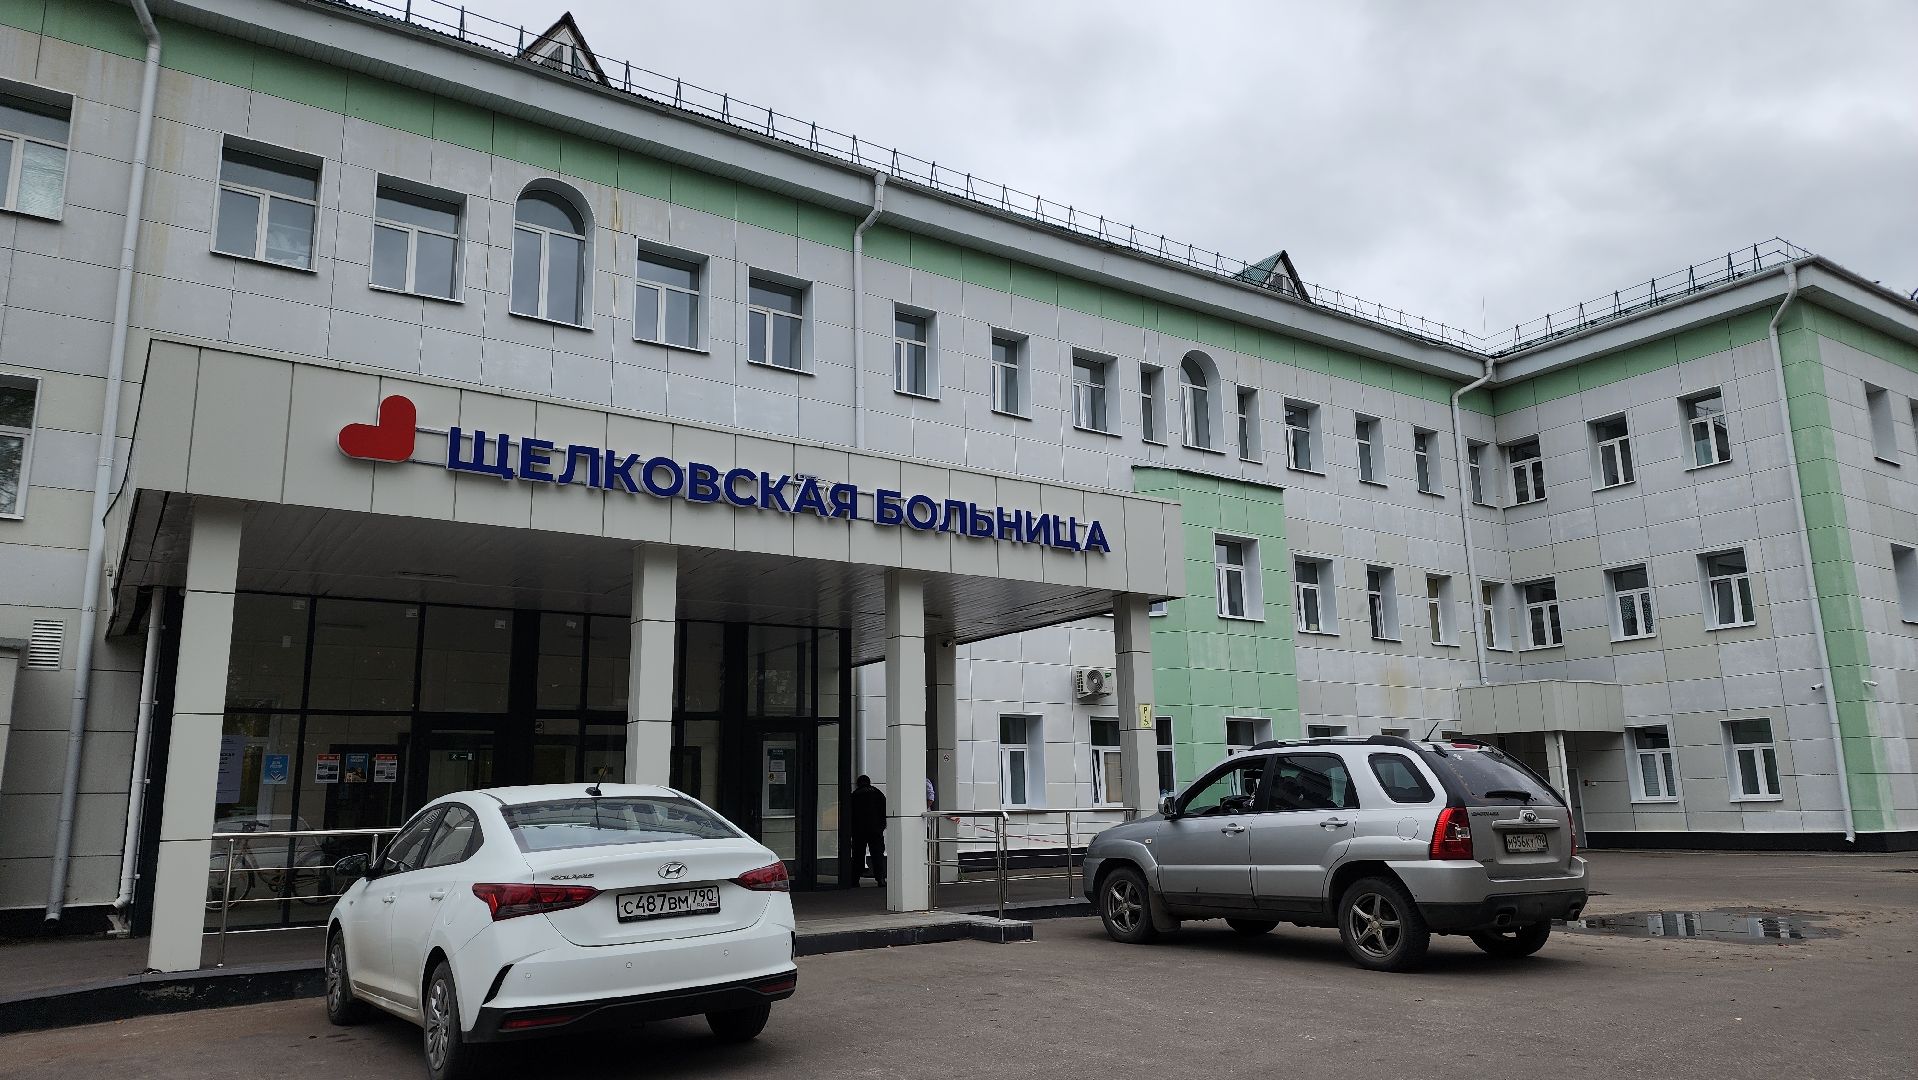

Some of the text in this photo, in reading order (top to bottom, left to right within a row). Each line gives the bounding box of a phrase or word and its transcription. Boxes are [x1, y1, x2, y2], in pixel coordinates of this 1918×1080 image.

[447, 426, 1111, 553] ЩЕЛКОВСКАЯ БОЛЬНИЦА
[690, 889, 714, 904] 790
